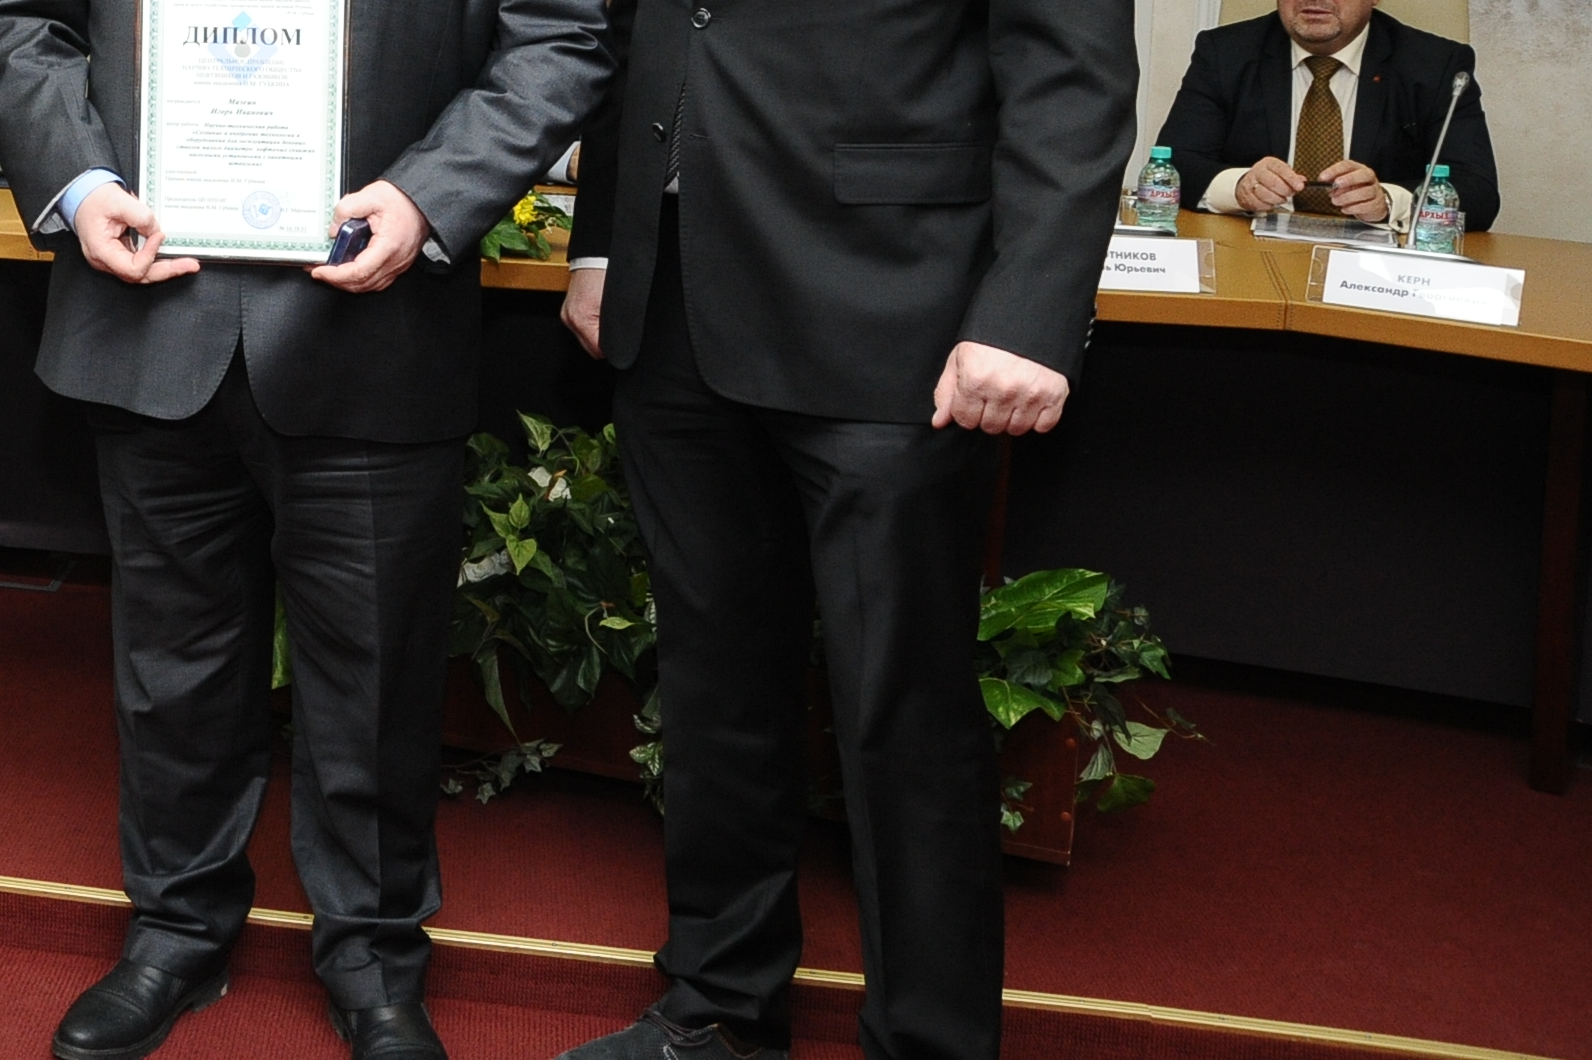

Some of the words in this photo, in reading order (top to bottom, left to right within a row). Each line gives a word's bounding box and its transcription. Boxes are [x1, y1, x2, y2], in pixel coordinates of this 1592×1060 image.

[182, 25, 302, 47] ДИПЛОМ
[1109, 250, 1157, 261] ТНИКОВ
[1114, 263, 1166, 274] Юрьевич
[1397, 274, 1431, 286] КЕРН
[1339, 280, 1409, 298] Александр
